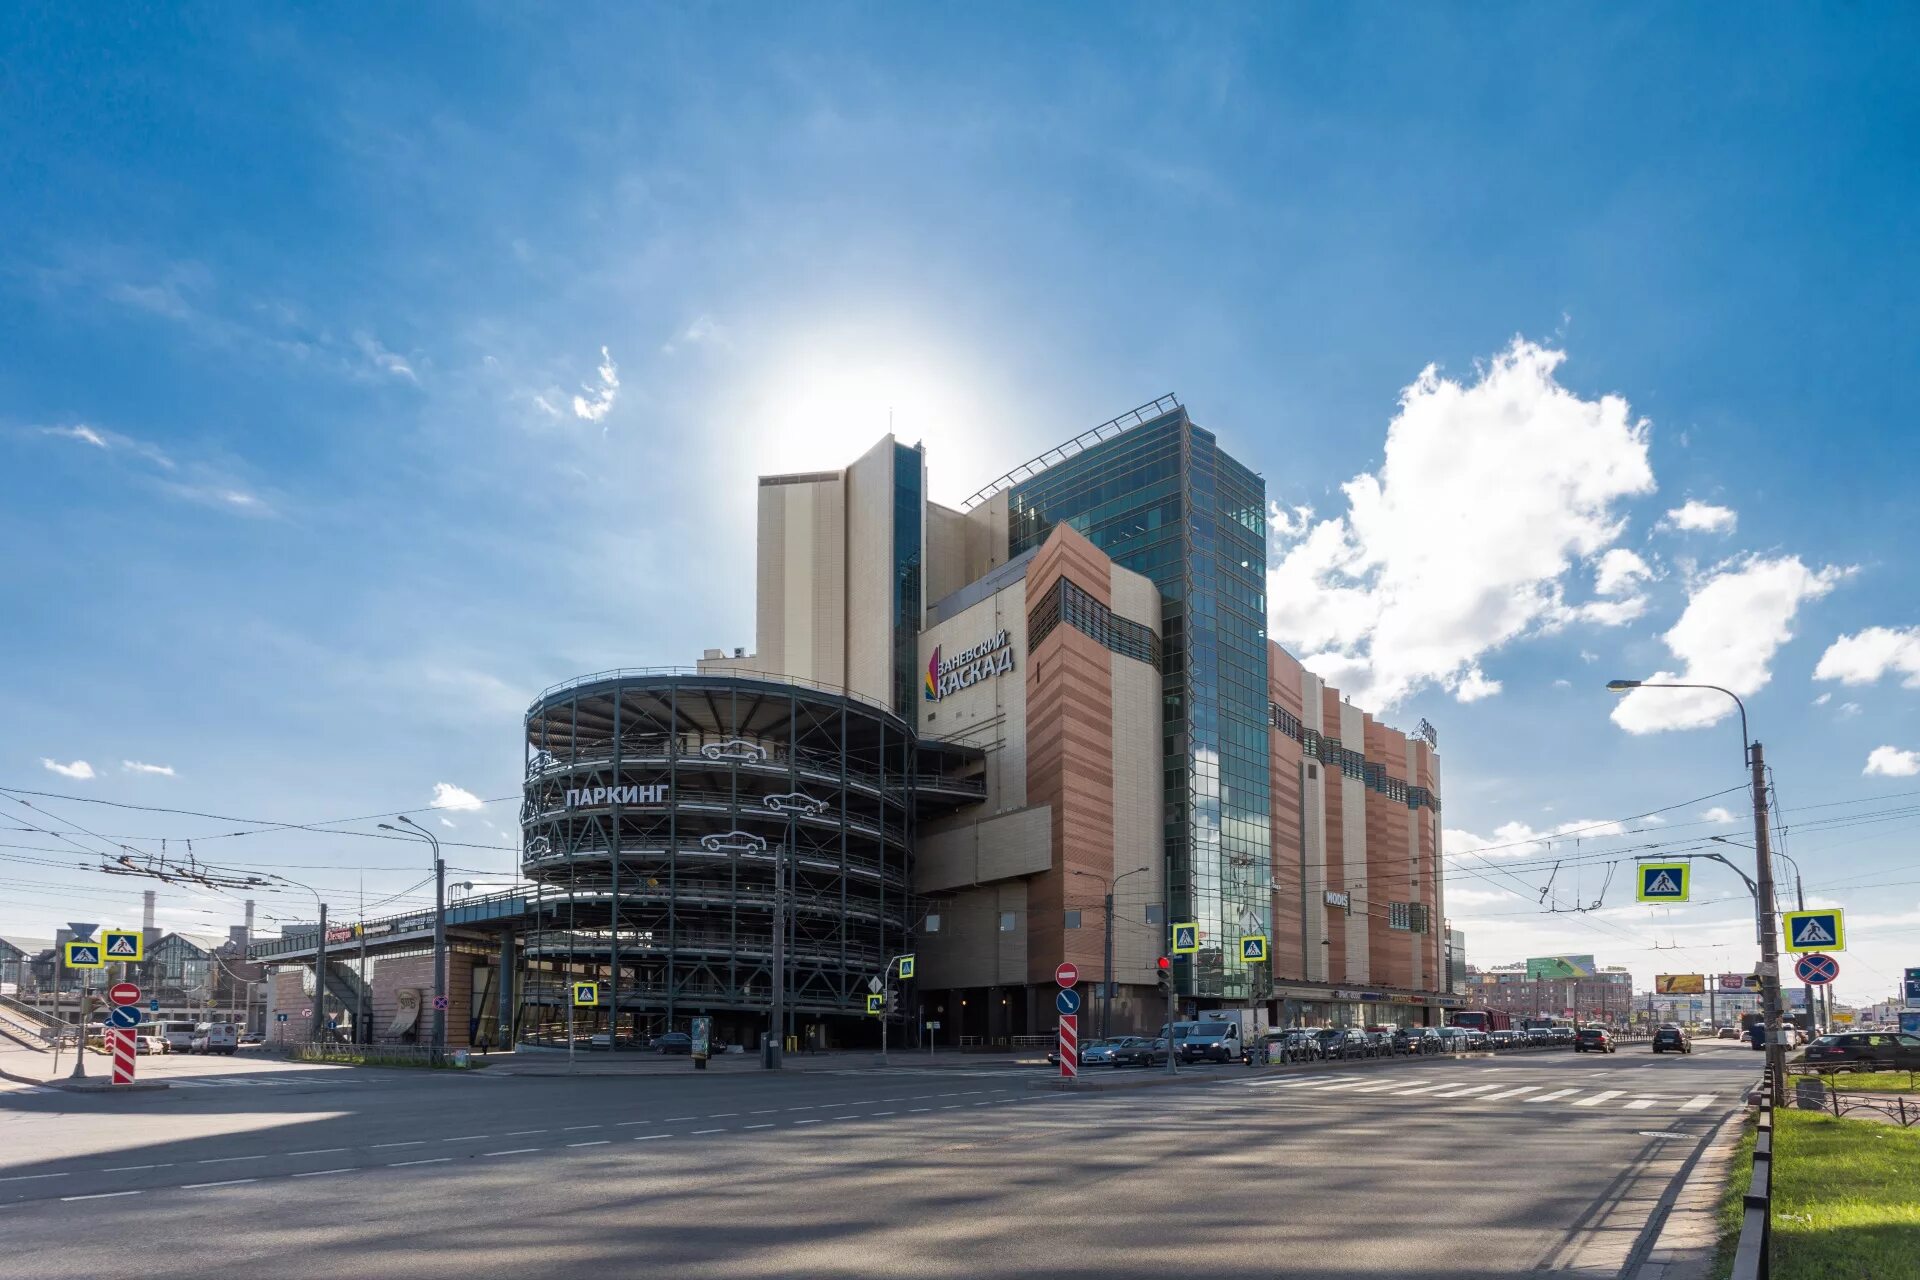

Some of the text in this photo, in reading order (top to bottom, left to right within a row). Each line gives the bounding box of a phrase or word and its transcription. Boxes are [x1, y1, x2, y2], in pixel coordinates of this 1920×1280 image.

[938, 628, 1006, 676] ЗАНЕВСКИЙ
[938, 646, 1014, 699] КАСКАД
[566, 784, 669, 807] ПАРКИНГ
[1327, 892, 1348, 907] MODIS
